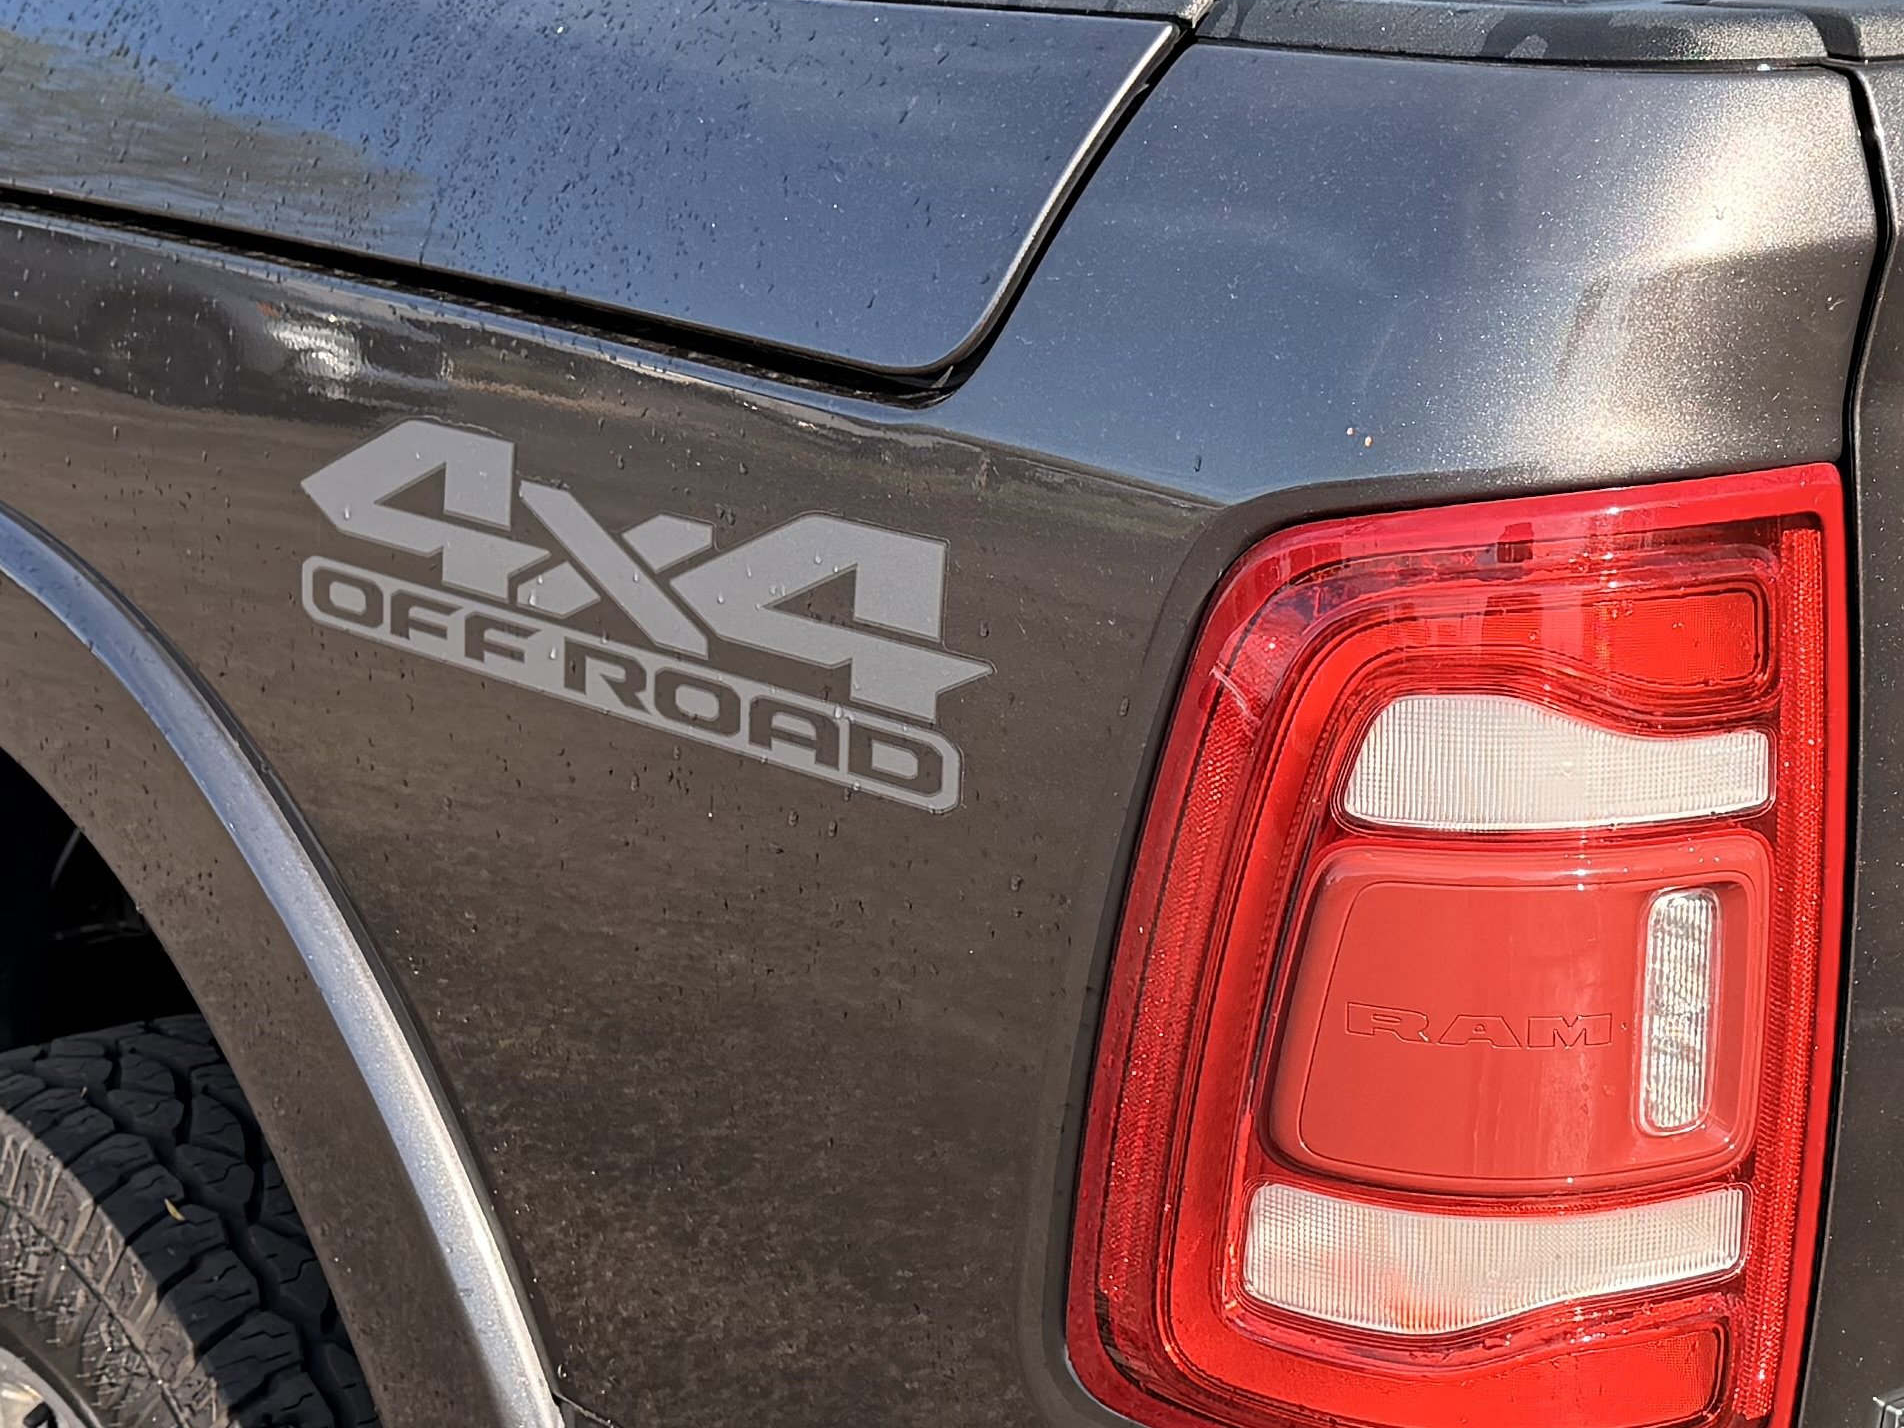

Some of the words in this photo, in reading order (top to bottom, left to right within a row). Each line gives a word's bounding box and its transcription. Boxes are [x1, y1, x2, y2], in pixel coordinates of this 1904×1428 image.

[311, 566, 542, 664] OFF
[563, 638, 944, 796] ROAD
[1346, 1000, 1613, 1050] RAM
